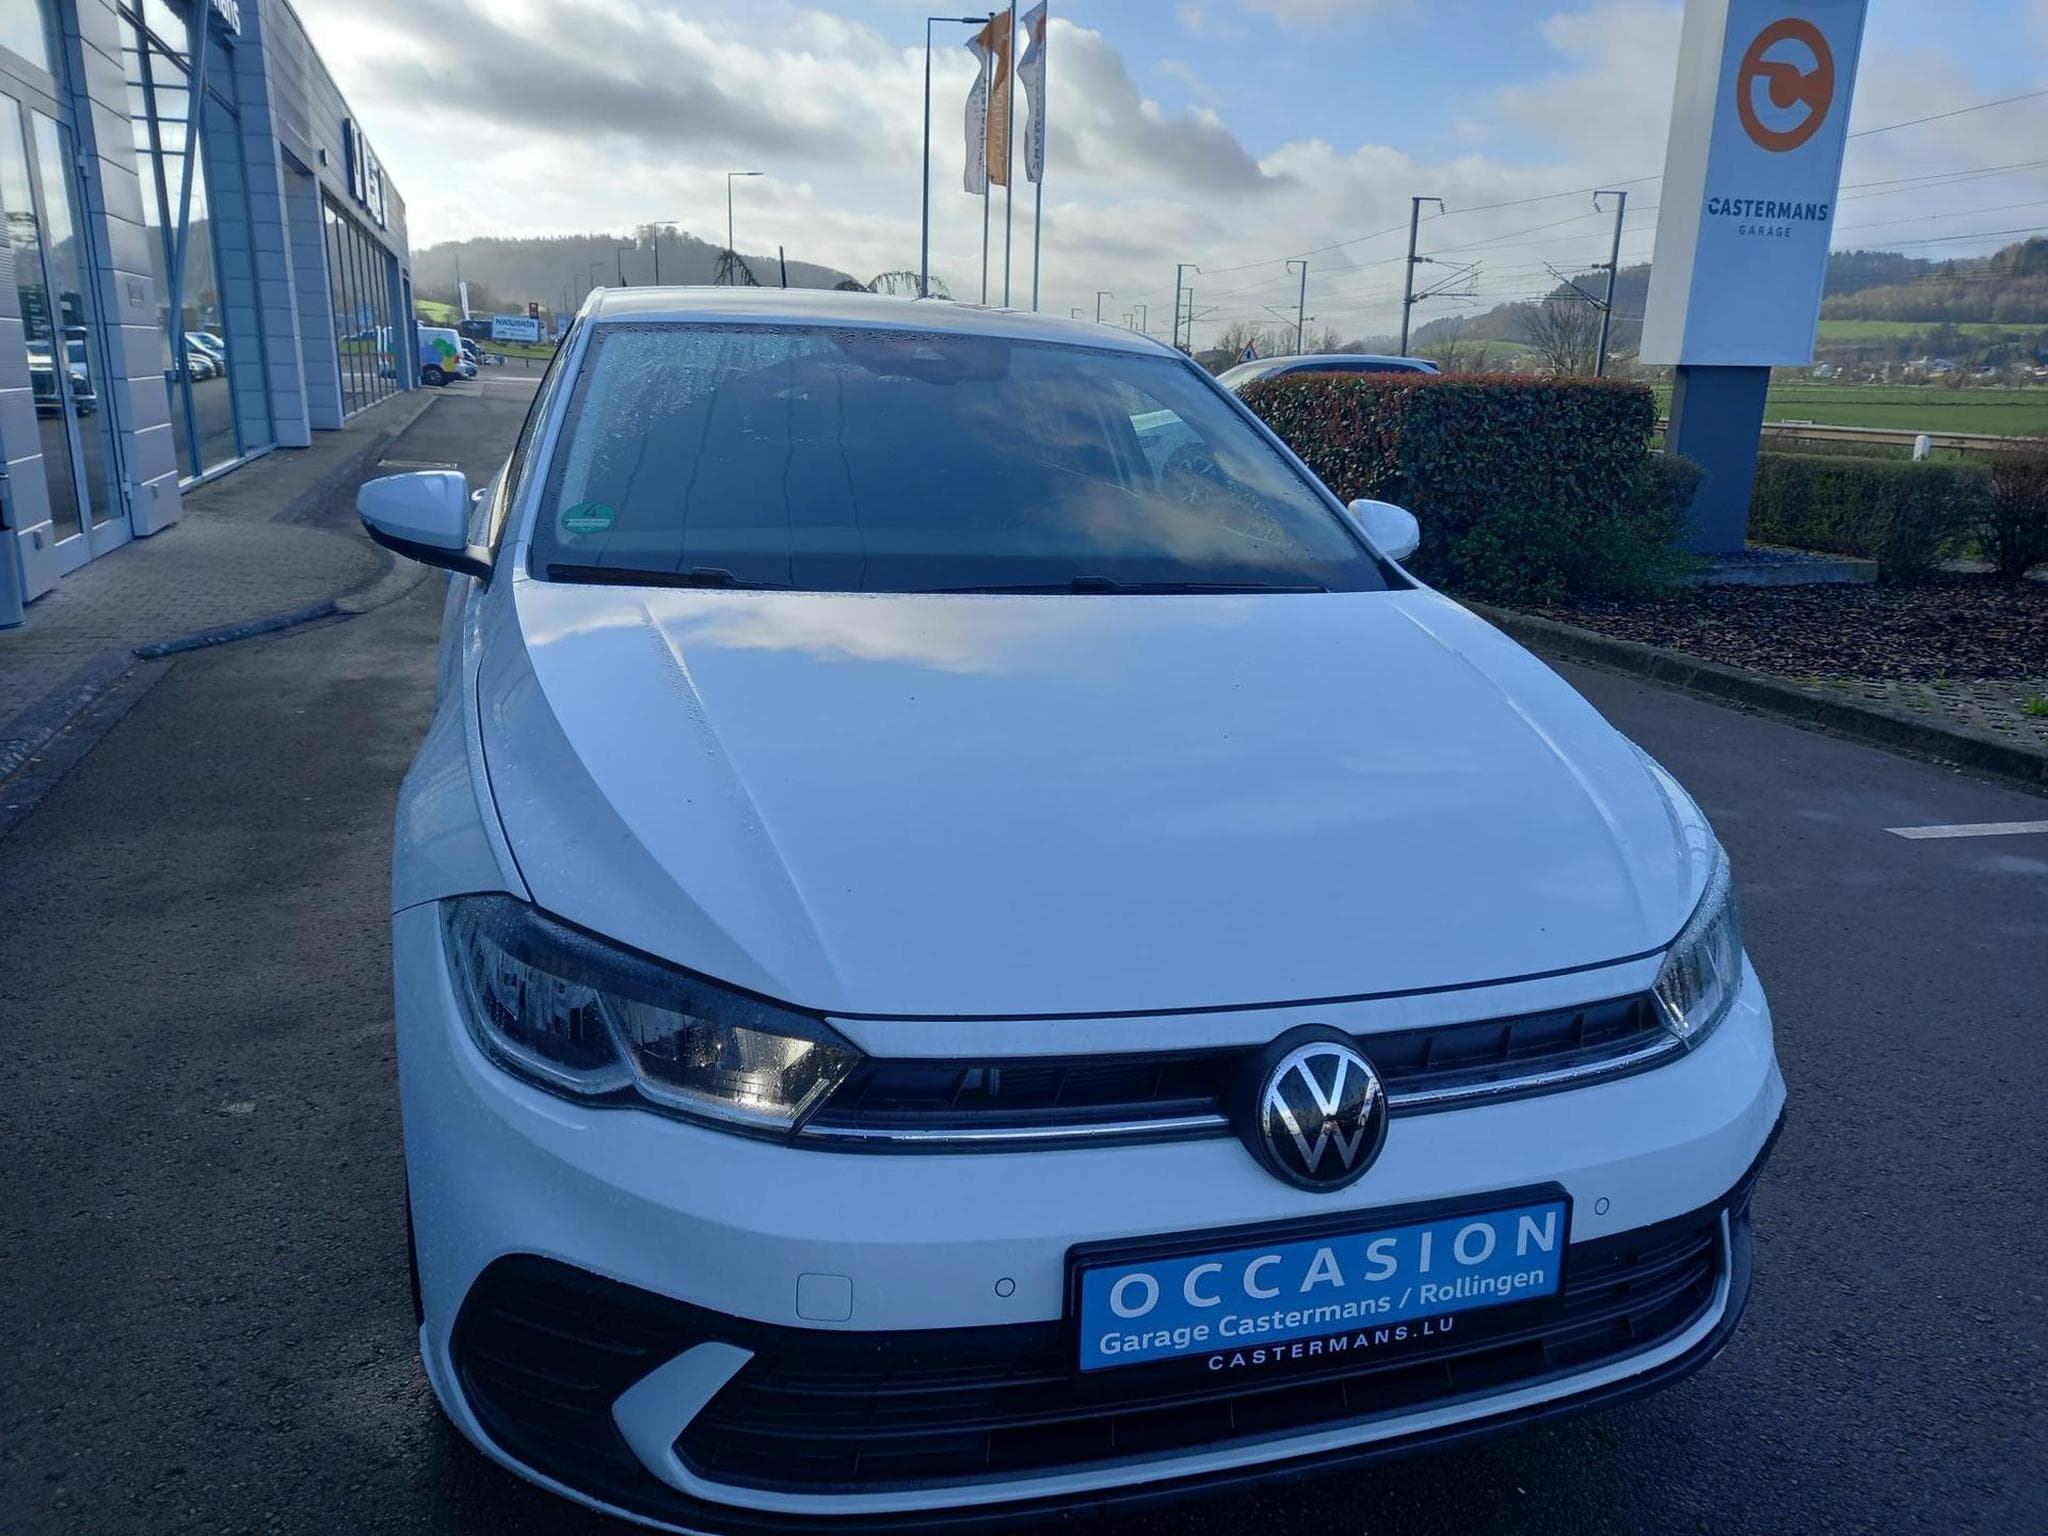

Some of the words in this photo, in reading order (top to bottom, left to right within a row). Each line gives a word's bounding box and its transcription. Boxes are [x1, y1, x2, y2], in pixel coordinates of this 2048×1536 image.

[1708, 197, 1829, 221] CASTERMANS
[1738, 225, 1791, 238] GARAGE
[1109, 1211, 1557, 1319] OCCASION
[1100, 1324, 1210, 1355] Garage
[1218, 1296, 1391, 1337] Castermans
[1398, 1287, 1412, 1309] /
[1419, 1269, 1544, 1305] Rollingen
[1208, 1317, 1454, 1371] CASTERMANS.LU
